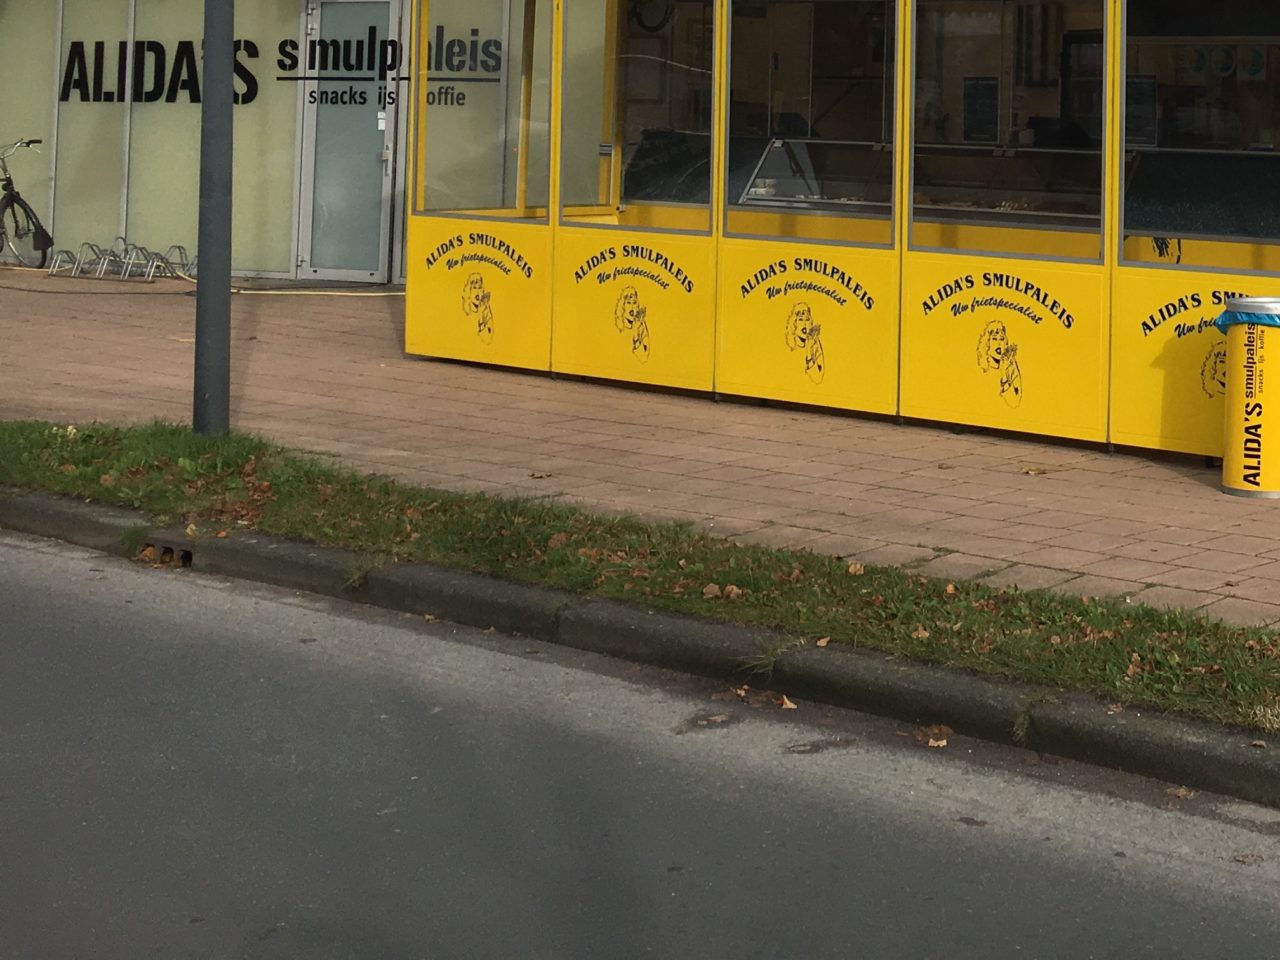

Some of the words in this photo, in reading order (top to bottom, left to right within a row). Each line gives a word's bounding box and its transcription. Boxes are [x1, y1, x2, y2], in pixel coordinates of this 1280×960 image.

[59, 39, 259, 105] ALIDAS
[276, 25, 502, 82] smulpleis
[308, 86, 368, 105] snacks
[378, 85, 396, 110] ijs
[426, 86, 466, 106] offie
[425, 235, 463, 270] ALIDA'S
[469, 232, 533, 279] SMULPALEIS
[574, 247, 616, 284] ALIDA'S
[622, 244, 695, 293] SMULPALEIS
[740, 260, 788, 299] ALIDA'S
[794, 257, 875, 311] SMULPALEIS
[765, 286, 782, 300] Uw
[784, 280, 847, 306] frietspecialist
[921, 274, 975, 316] ALIDA'S
[982, 272, 1075, 329] SMULPALEIS
[950, 302, 969, 317] Uw
[970, 296, 1043, 325] frietspecialist
[1140, 293, 1203, 337] ALIDA'S
[1174, 322, 1196, 339] Uw
[1243, 323, 1257, 399] smulpaleis
[1257, 369, 1265, 394] snacks
[1243, 402, 1263, 487] ALIDA'S
